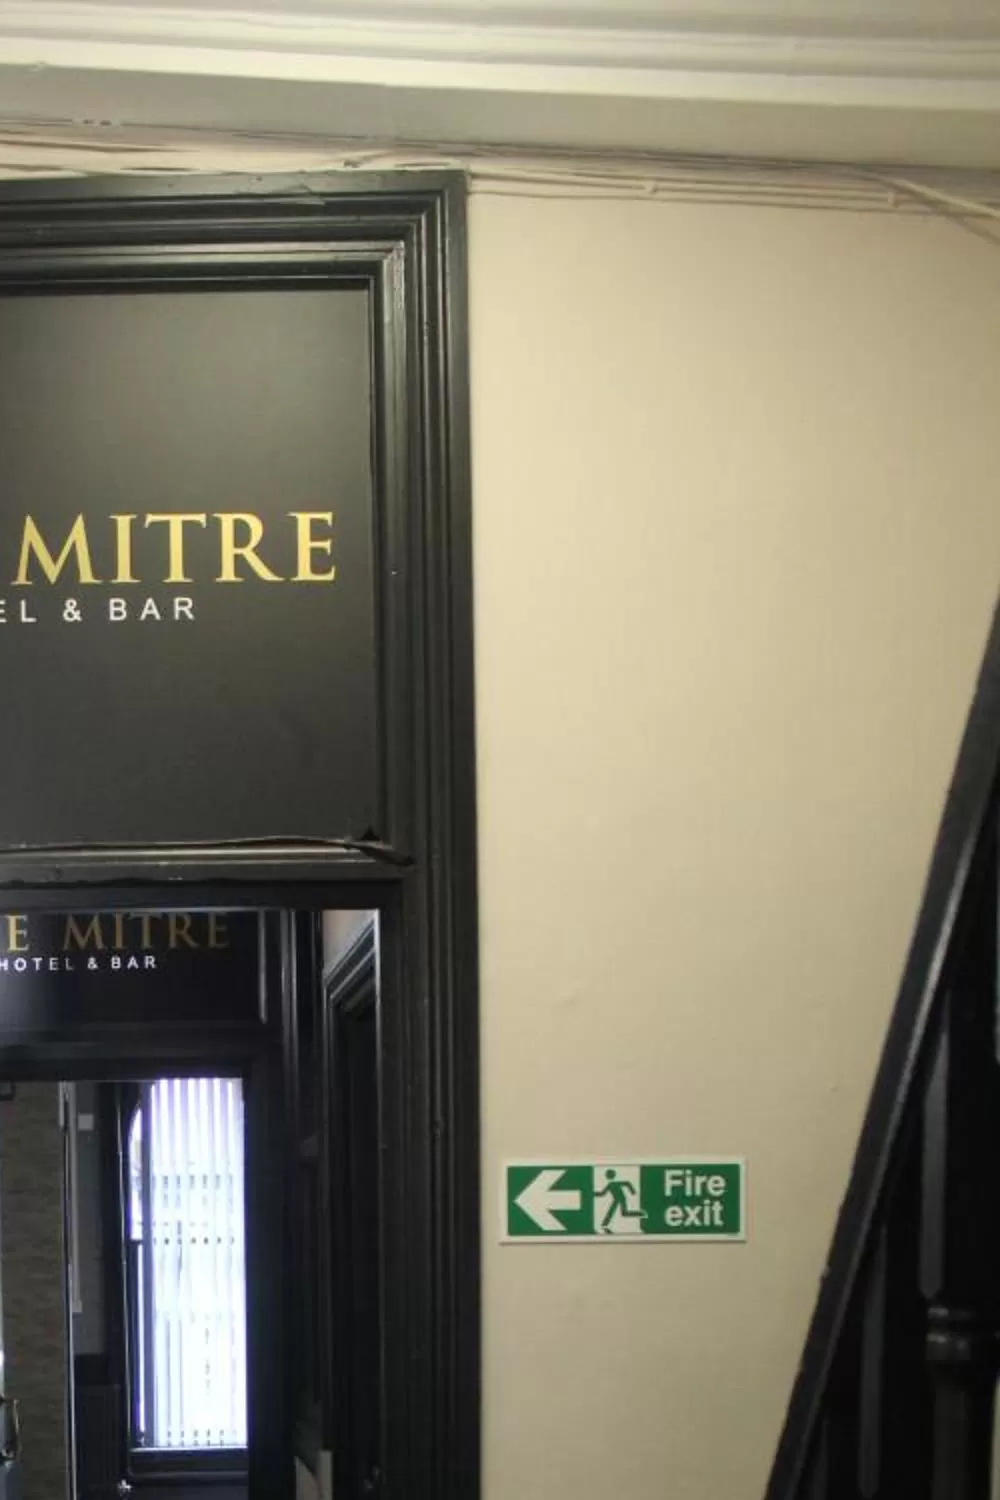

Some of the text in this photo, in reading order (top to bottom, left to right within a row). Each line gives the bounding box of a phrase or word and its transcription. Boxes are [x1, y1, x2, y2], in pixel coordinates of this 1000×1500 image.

[10, 511, 336, 585] MITRE
[63, 599, 83, 622] &
[109, 597, 195, 621] BAR
[63, 911, 230, 952] MITRE
[87, 955, 99, 971] &
[111, 955, 157, 970] BAR
[664, 1169, 726, 1197] Fire
[664, 1200, 724, 1227] exit
